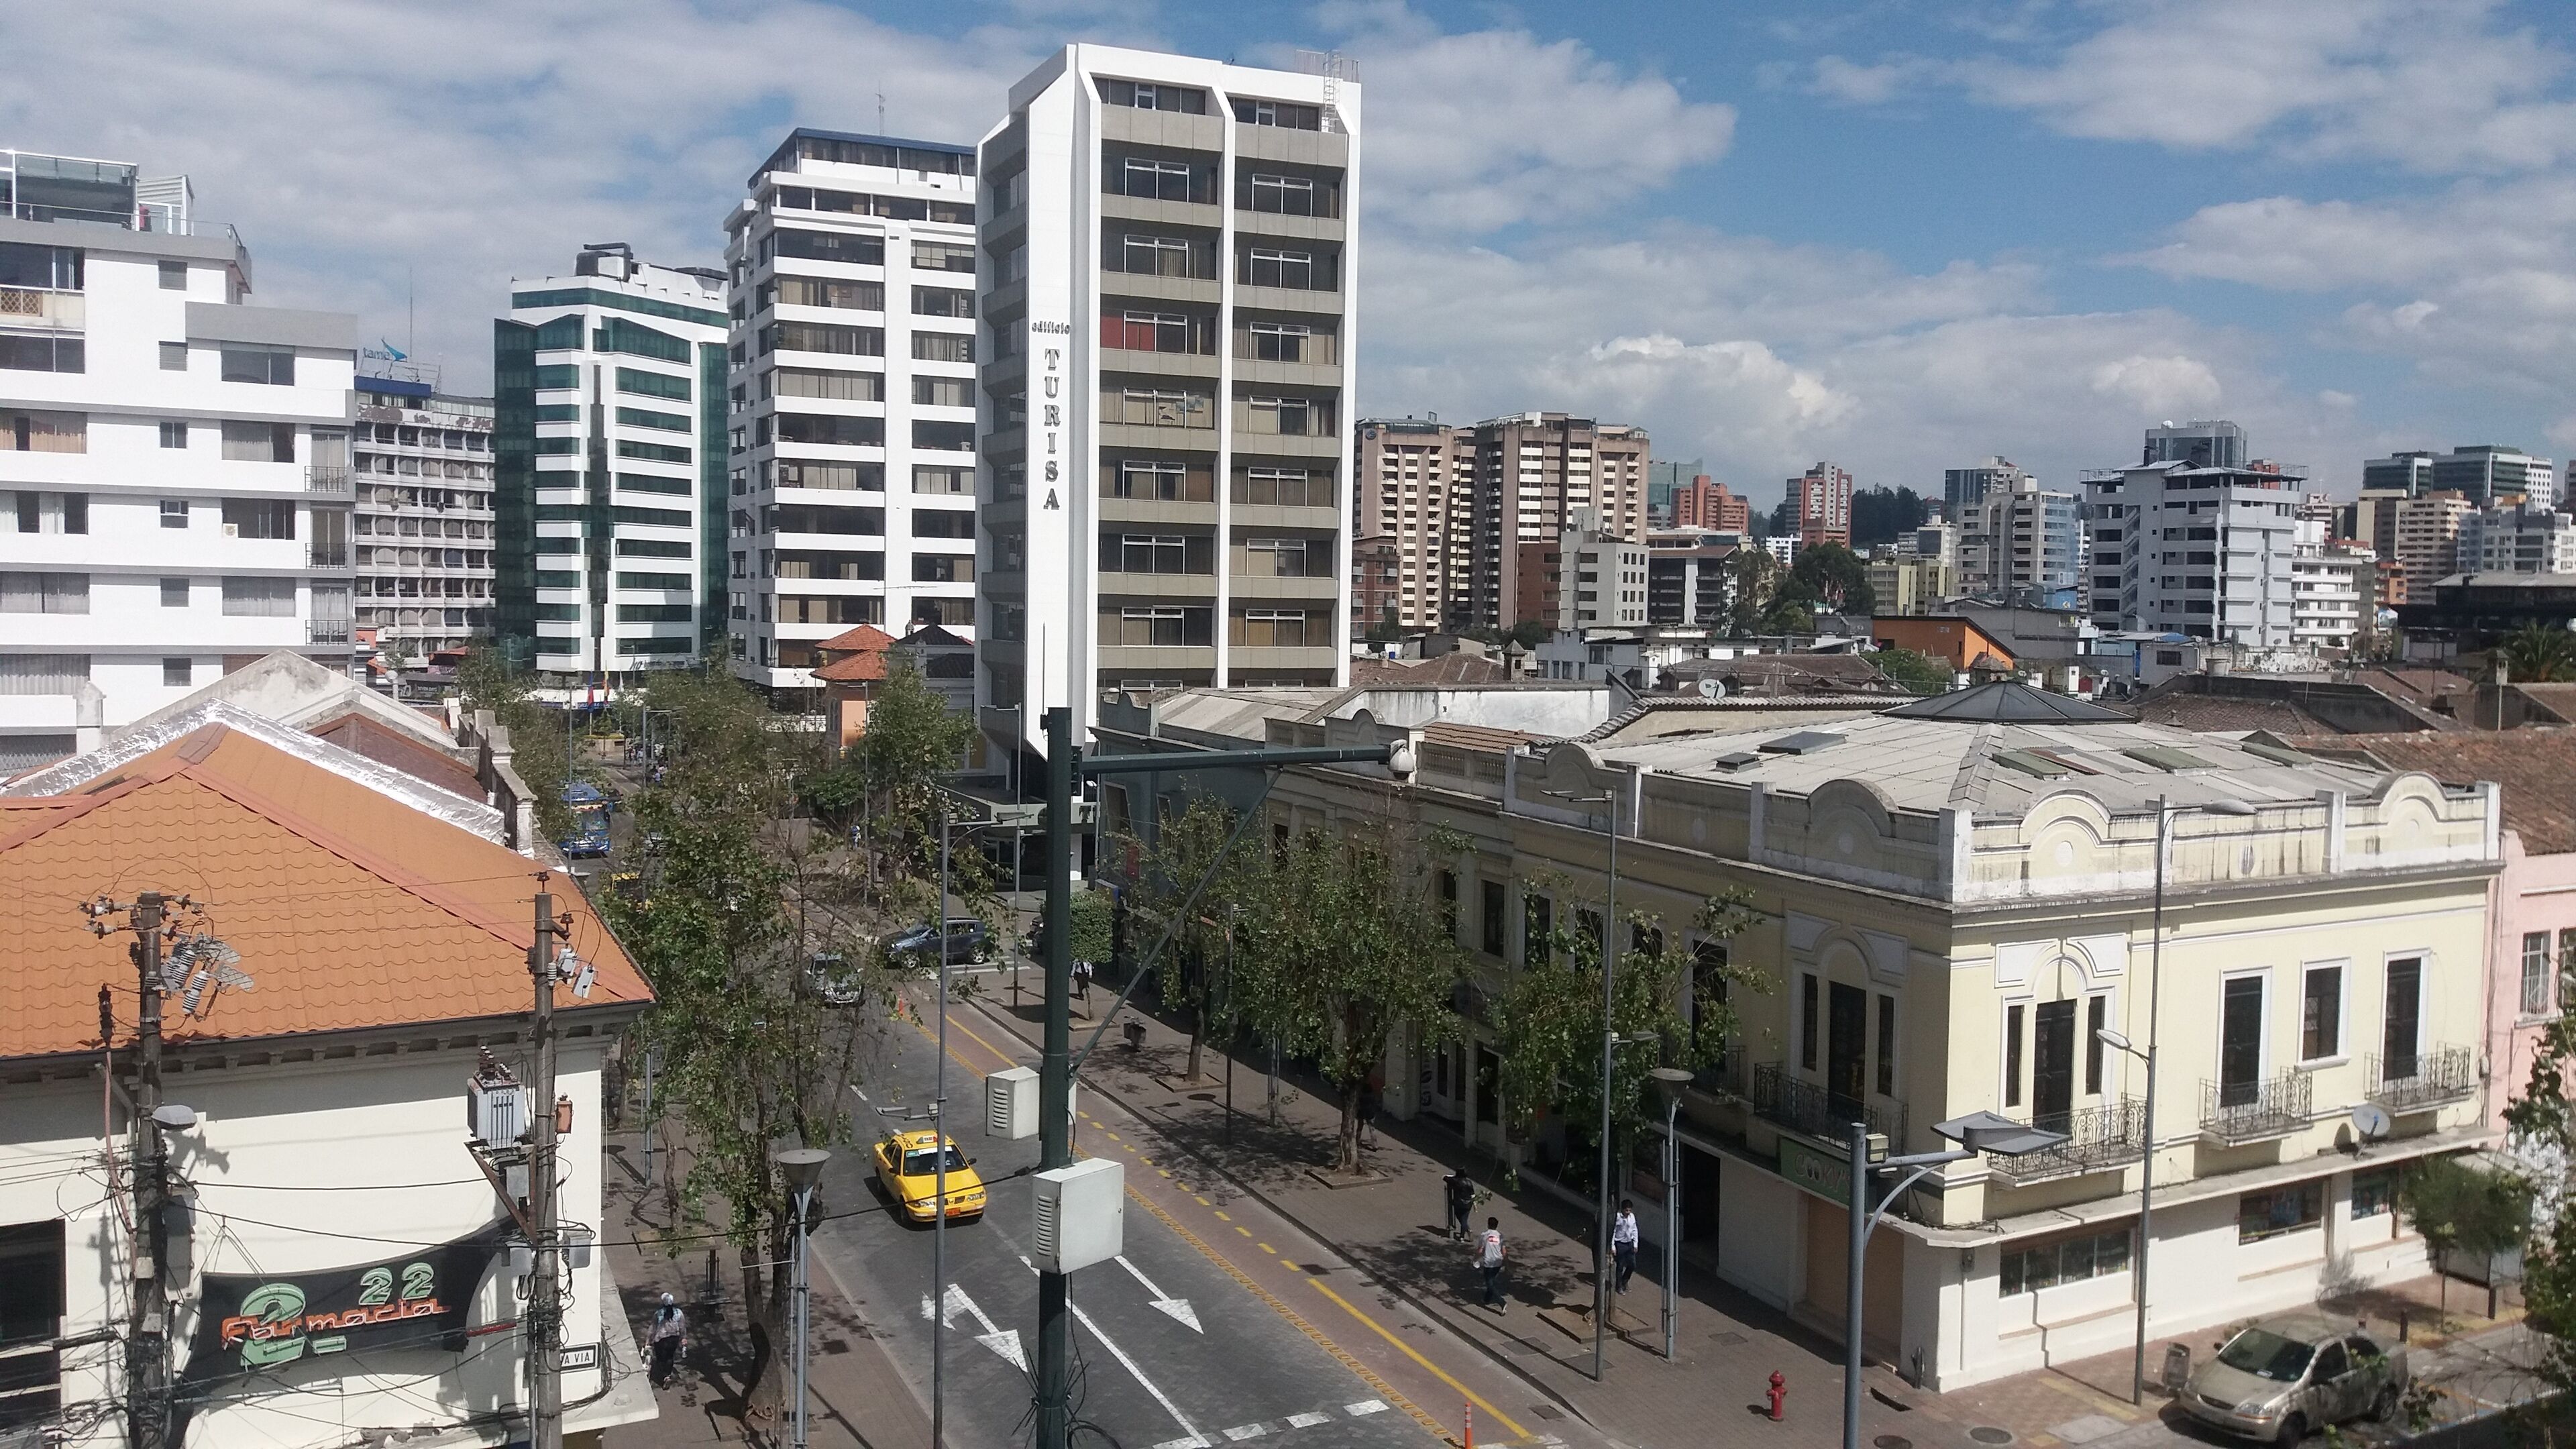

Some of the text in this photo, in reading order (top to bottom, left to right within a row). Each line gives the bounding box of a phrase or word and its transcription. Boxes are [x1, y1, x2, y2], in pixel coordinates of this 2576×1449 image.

[1032, 321, 1071, 335] edificio
[1043, 348, 1061, 510] TURISA
[574, 1352, 590, 1362] VIA
